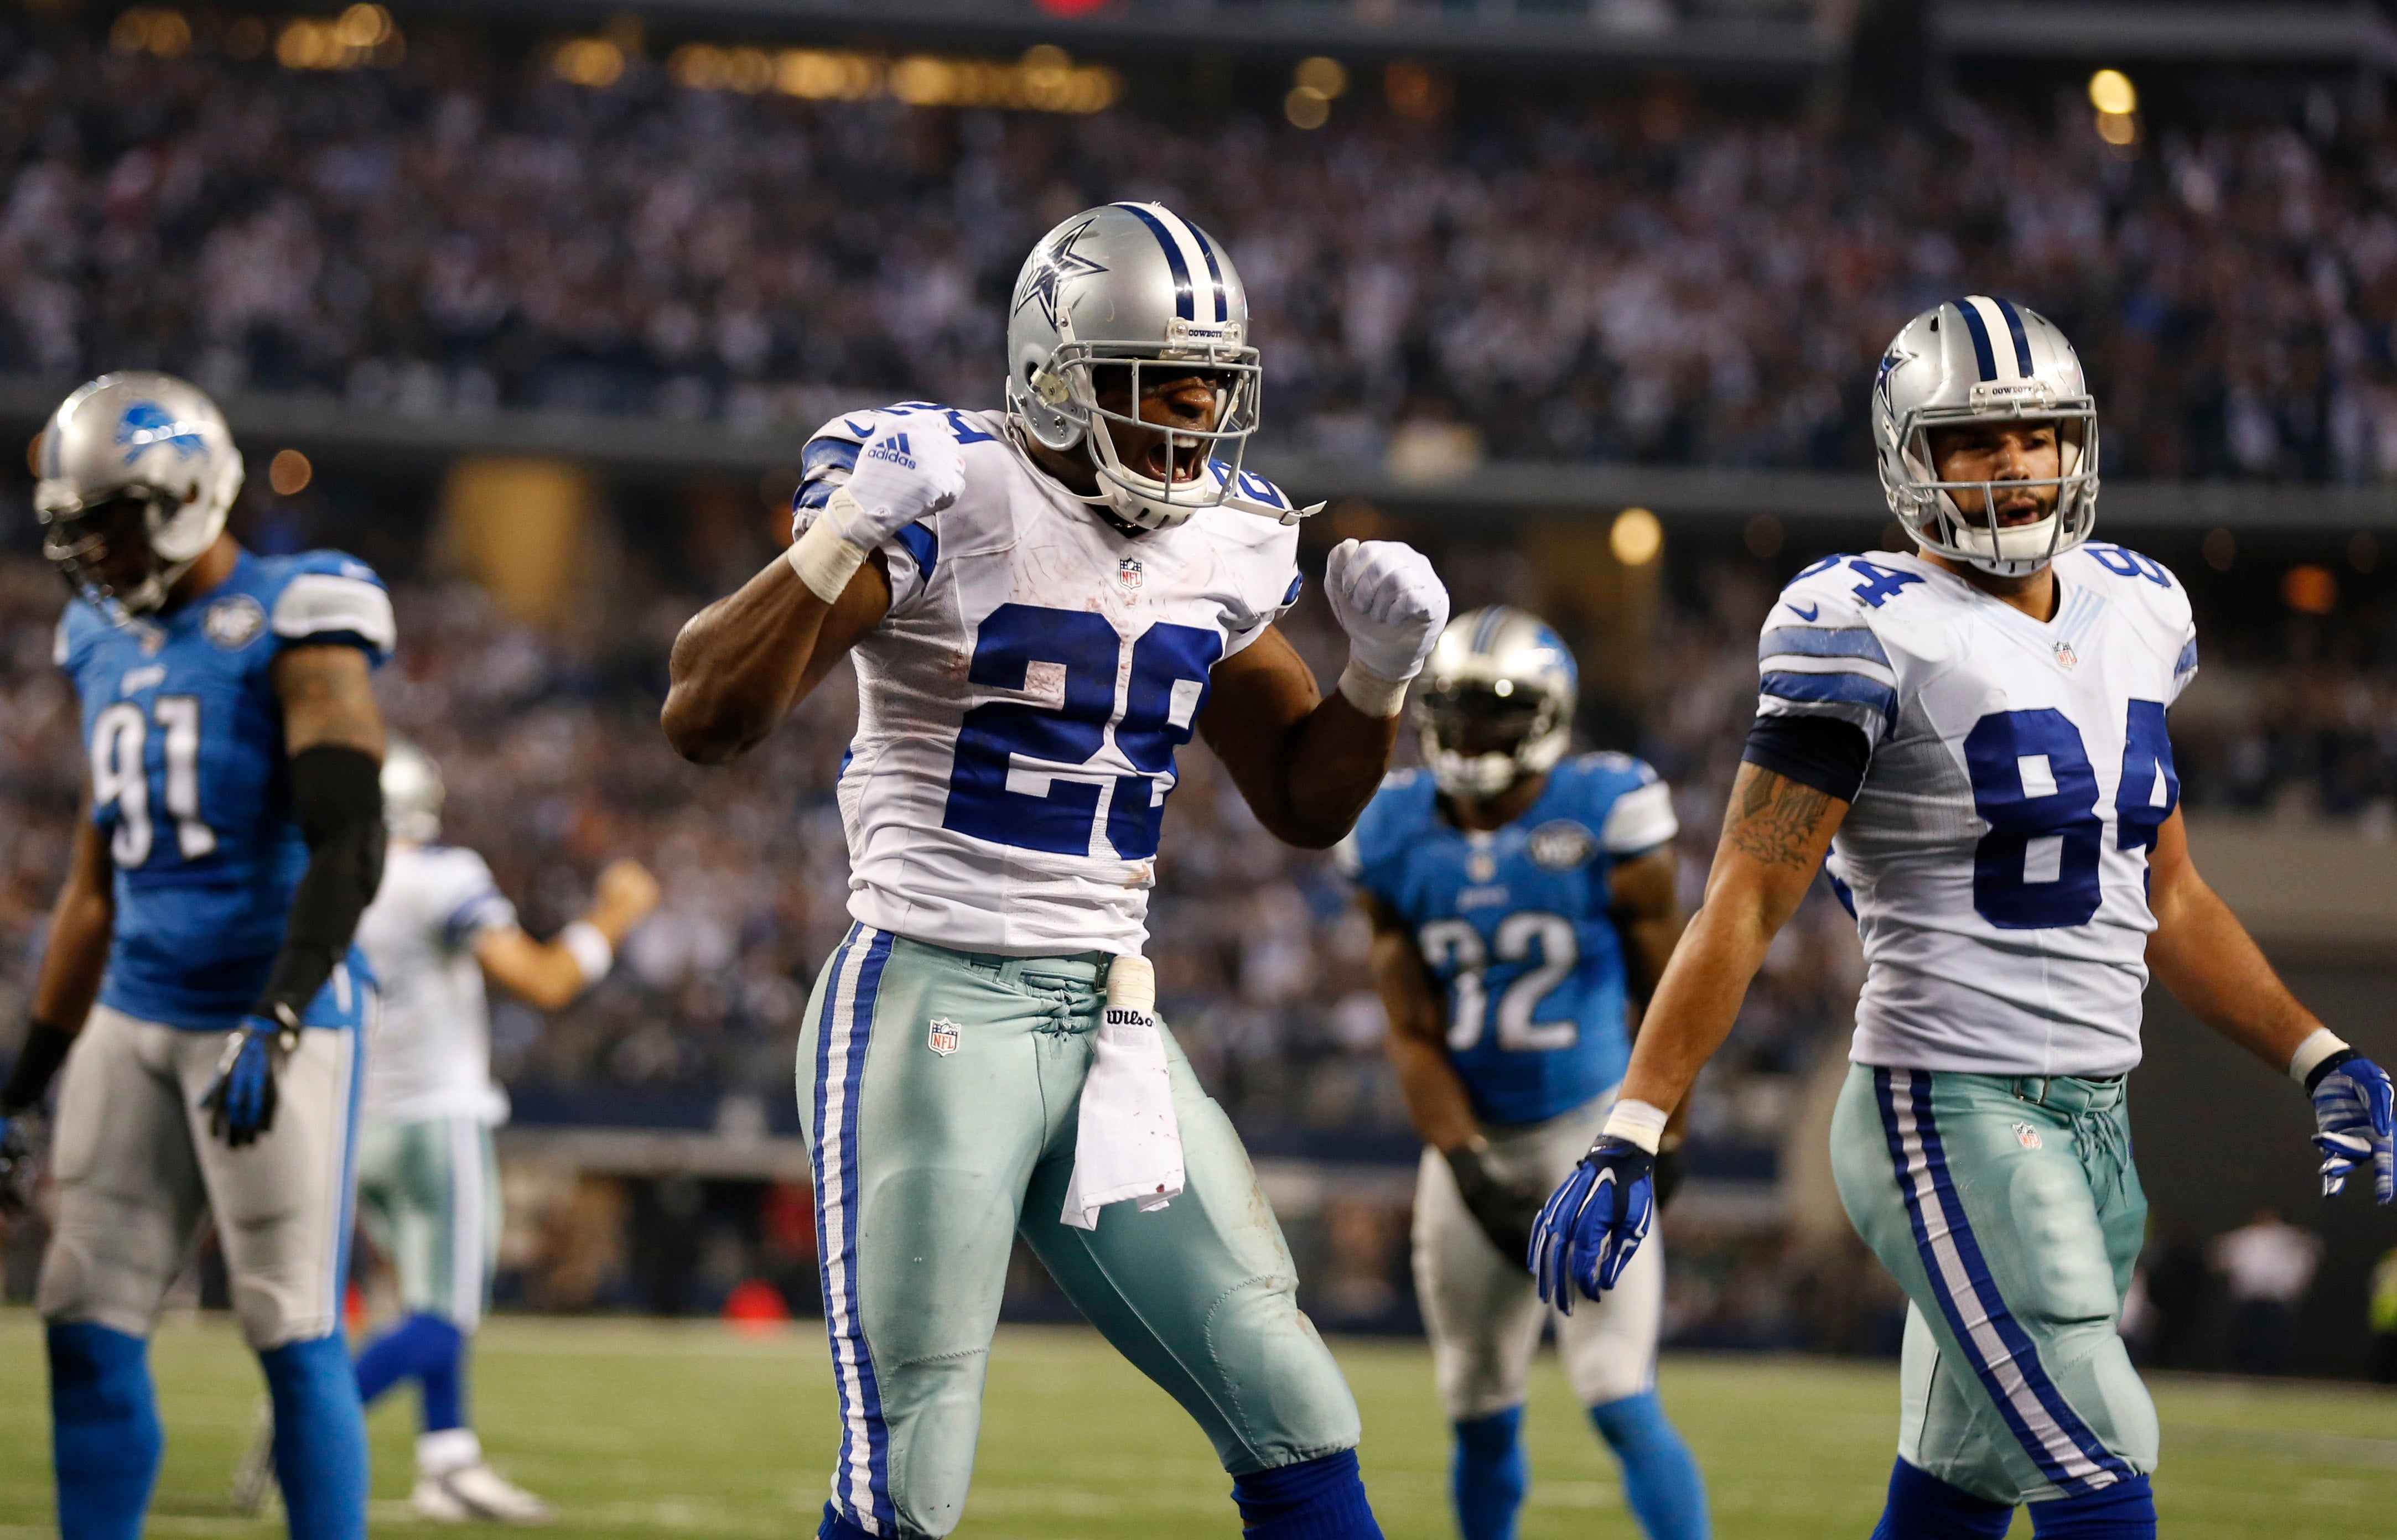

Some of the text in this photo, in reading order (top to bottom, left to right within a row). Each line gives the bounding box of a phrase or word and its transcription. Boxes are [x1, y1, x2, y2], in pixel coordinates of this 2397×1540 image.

[868, 448, 916, 470] adidas
[1122, 570, 1141, 586] NFL
[942, 602, 1223, 861] 29
[90, 695, 218, 870] 91
[1963, 696, 2180, 929] 84
[1106, 1010, 1154, 1027] Wilso
[933, 1033, 954, 1050] NFL
